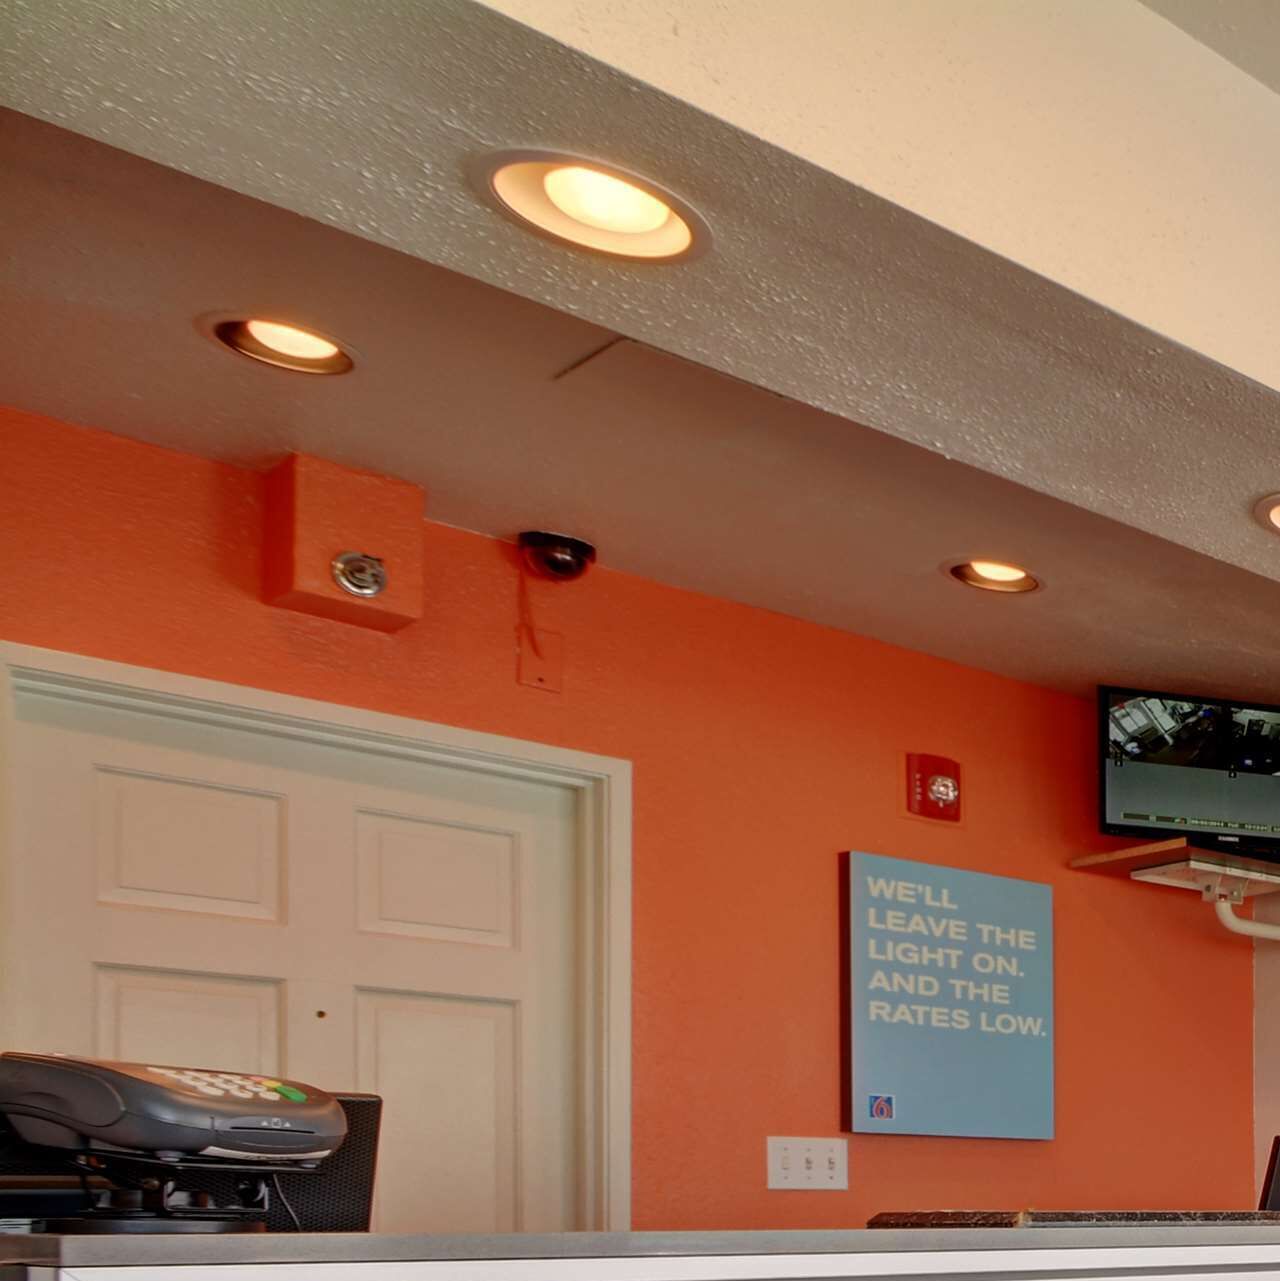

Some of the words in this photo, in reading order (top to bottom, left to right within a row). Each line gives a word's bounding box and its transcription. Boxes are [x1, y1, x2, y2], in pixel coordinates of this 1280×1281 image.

[867, 876, 958, 910] WE'LL
[867, 907, 968, 941] LEAVE
[976, 923, 1037, 951] THE
[868, 939, 964, 969] LIGHT
[972, 952, 1025, 977] ON.
[868, 970, 940, 997] AND
[948, 978, 1011, 1005] THE
[869, 1000, 971, 1030] RATES
[980, 1011, 1047, 1037] LOW.
